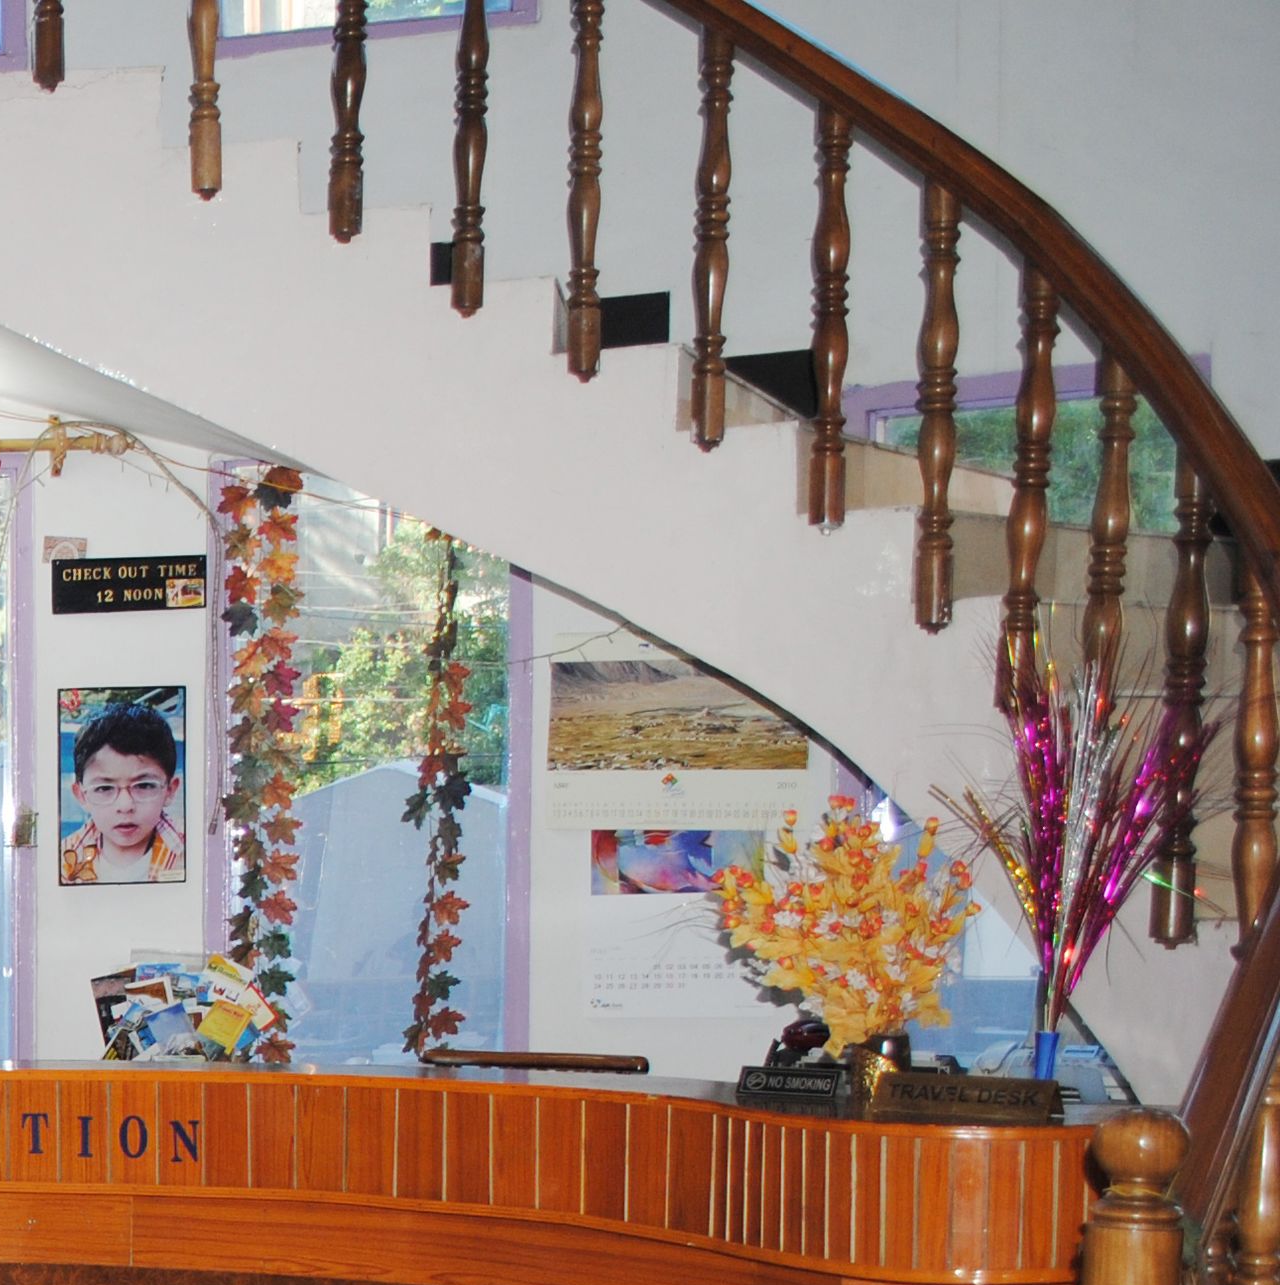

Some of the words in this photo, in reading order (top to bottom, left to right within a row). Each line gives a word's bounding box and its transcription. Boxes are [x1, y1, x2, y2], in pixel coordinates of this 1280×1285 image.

[62, 566, 112, 582] CHECK
[118, 565, 150, 579] OUT
[157, 563, 197, 577] TIME
[96, 588, 114, 603] 12
[123, 587, 164, 602] NOON
[776, 781, 798, 790] 2010
[768, 1076, 782, 1087] NO
[784, 1077, 832, 1090] SMOKING
[890, 1083, 966, 1102] TRAVEL
[977, 1087, 1039, 1106] DESK
